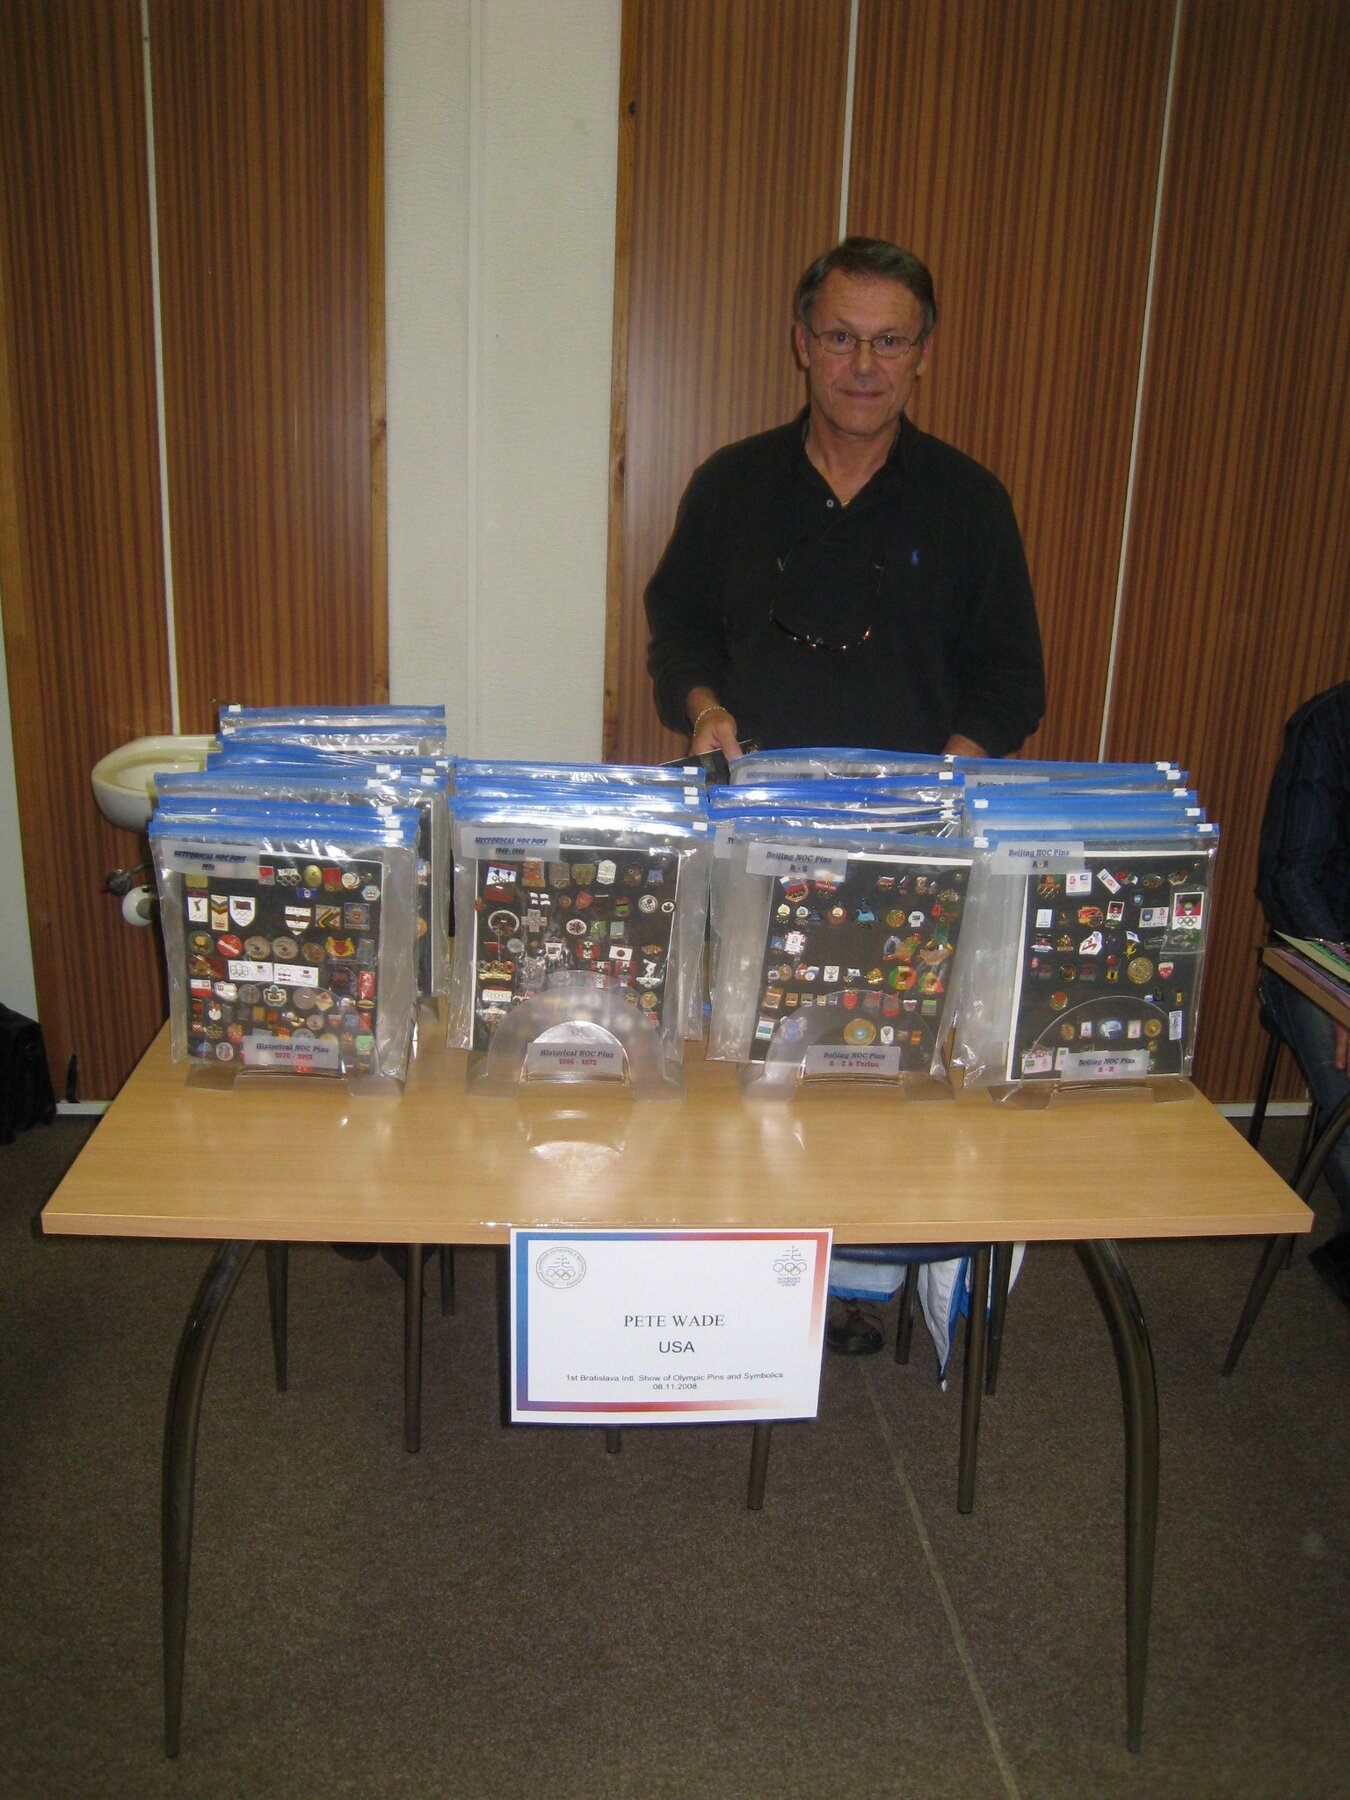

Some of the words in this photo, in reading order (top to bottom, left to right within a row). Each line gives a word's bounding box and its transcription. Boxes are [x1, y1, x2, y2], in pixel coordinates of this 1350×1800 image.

[766, 851, 795, 862] Beijing
[796, 854, 814, 862] NOC
[814, 855, 833, 864] Pins
[1008, 849, 1036, 858] Beijing
[1053, 849, 1070, 857] Pins
[256, 1042, 293, 1051] Historical
[294, 1044, 311, 1052] NOC
[313, 1045, 329, 1053] Pins
[540, 1049, 577, 1057] Historical
[597, 1050, 614, 1058] Pins
[824, 1052, 849, 1060] Beijing
[869, 1052, 886, 1060] Pins
[855, 1060, 880, 1068] Torino
[1079, 1058, 1103, 1067] Beijing
[1120, 1057, 1136, 1065] Pins
[624, 1315, 666, 1328] PETE
[672, 1314, 725, 1327] WADE
[659, 1341, 695, 1354] USA
[566, 1374, 578, 1382] 1st
[663, 1374, 671, 1382] of
[673, 1374, 705, 1383] Olympic
[707, 1373, 725, 1381] Pins
[744, 1372, 784, 1381] Symbolics
[652, 1382, 698, 1391] 08.11.2008
